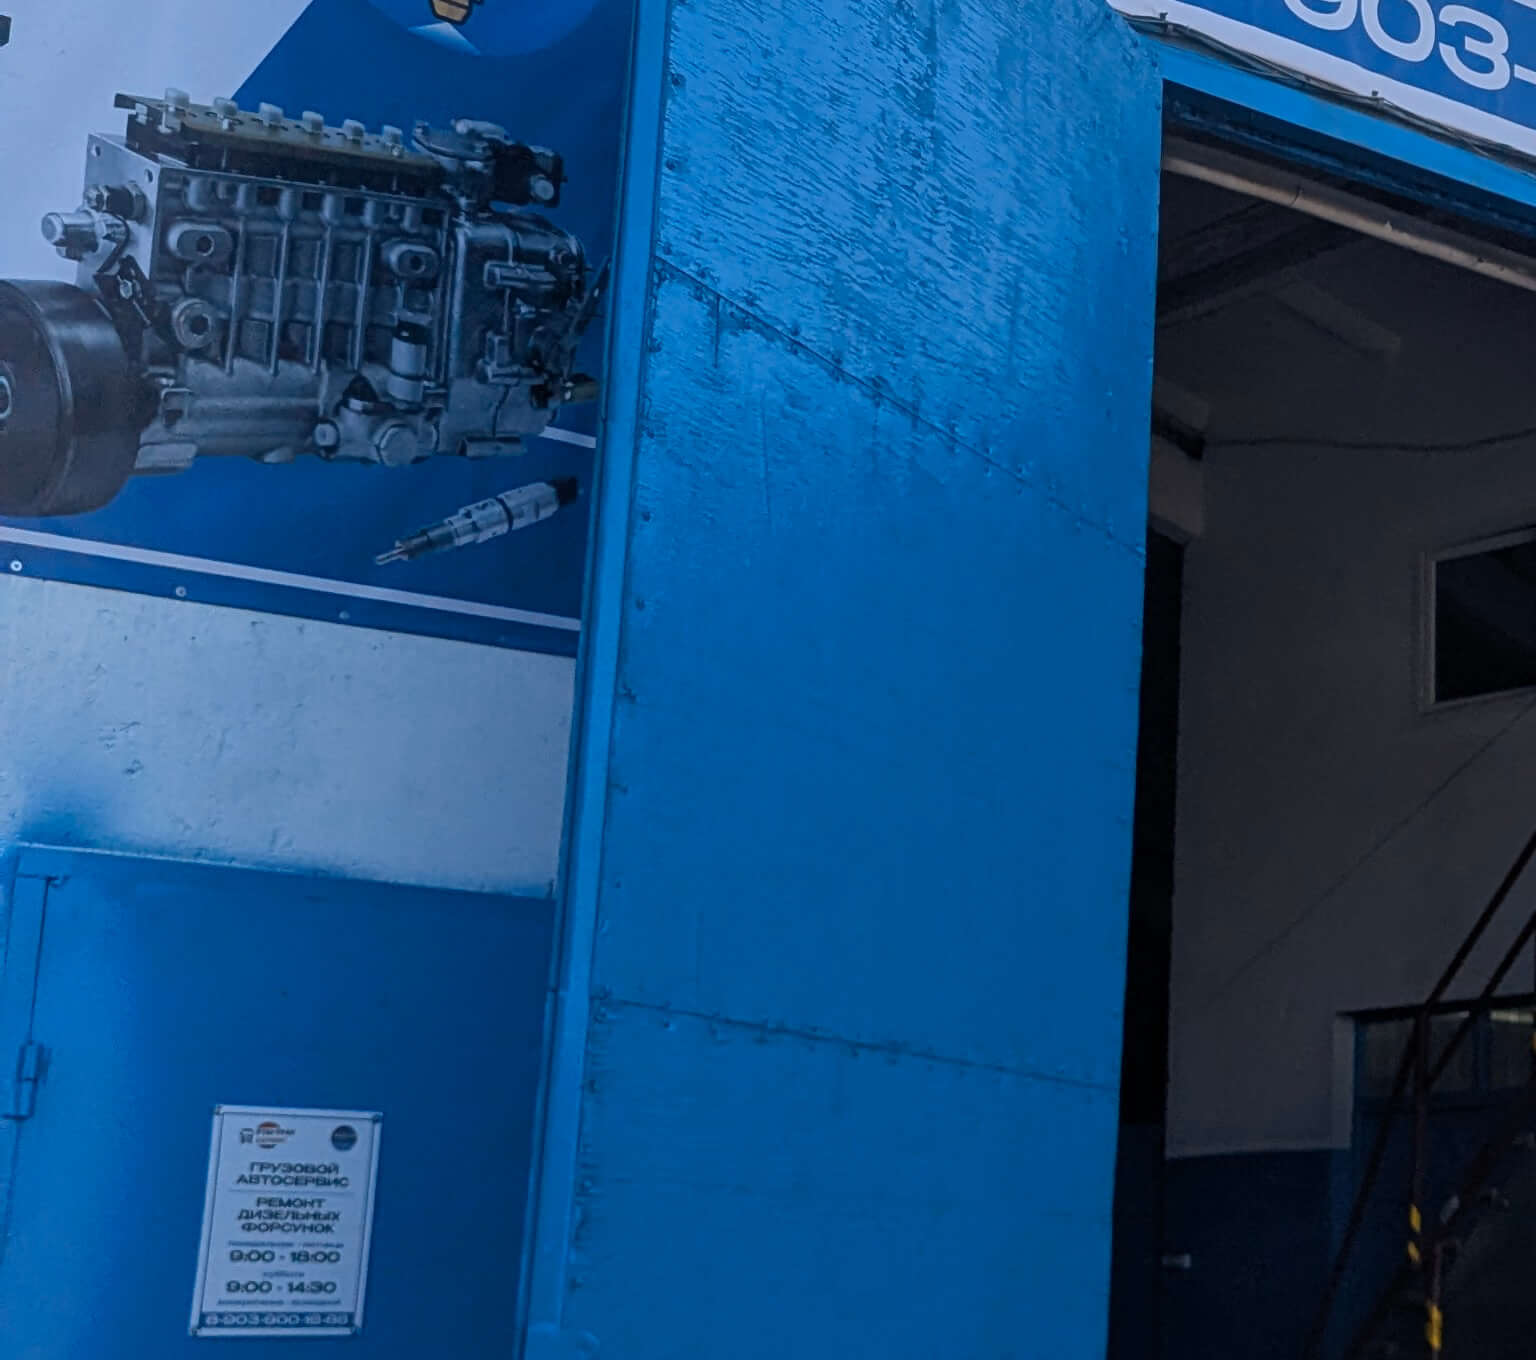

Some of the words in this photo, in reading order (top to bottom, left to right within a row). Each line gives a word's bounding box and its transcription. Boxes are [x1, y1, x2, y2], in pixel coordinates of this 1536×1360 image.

[250, 1161, 340, 1174] ГРУЗОВОЙ
[236, 1174, 349, 1187] АВТОСЕРВИС
[256, 1196, 326, 1209] РЕМОНТ
[237, 1209, 340, 1222] ДИЗЕЛЬНЫХ
[241, 1222, 335, 1233] ФОРСУНОК
[229, 1249, 276, 1263] 9:00
[290, 1250, 341, 1264] 18:00
[226, 1280, 273, 1294] 9:00
[287, 1281, 337, 1294] 14:30
